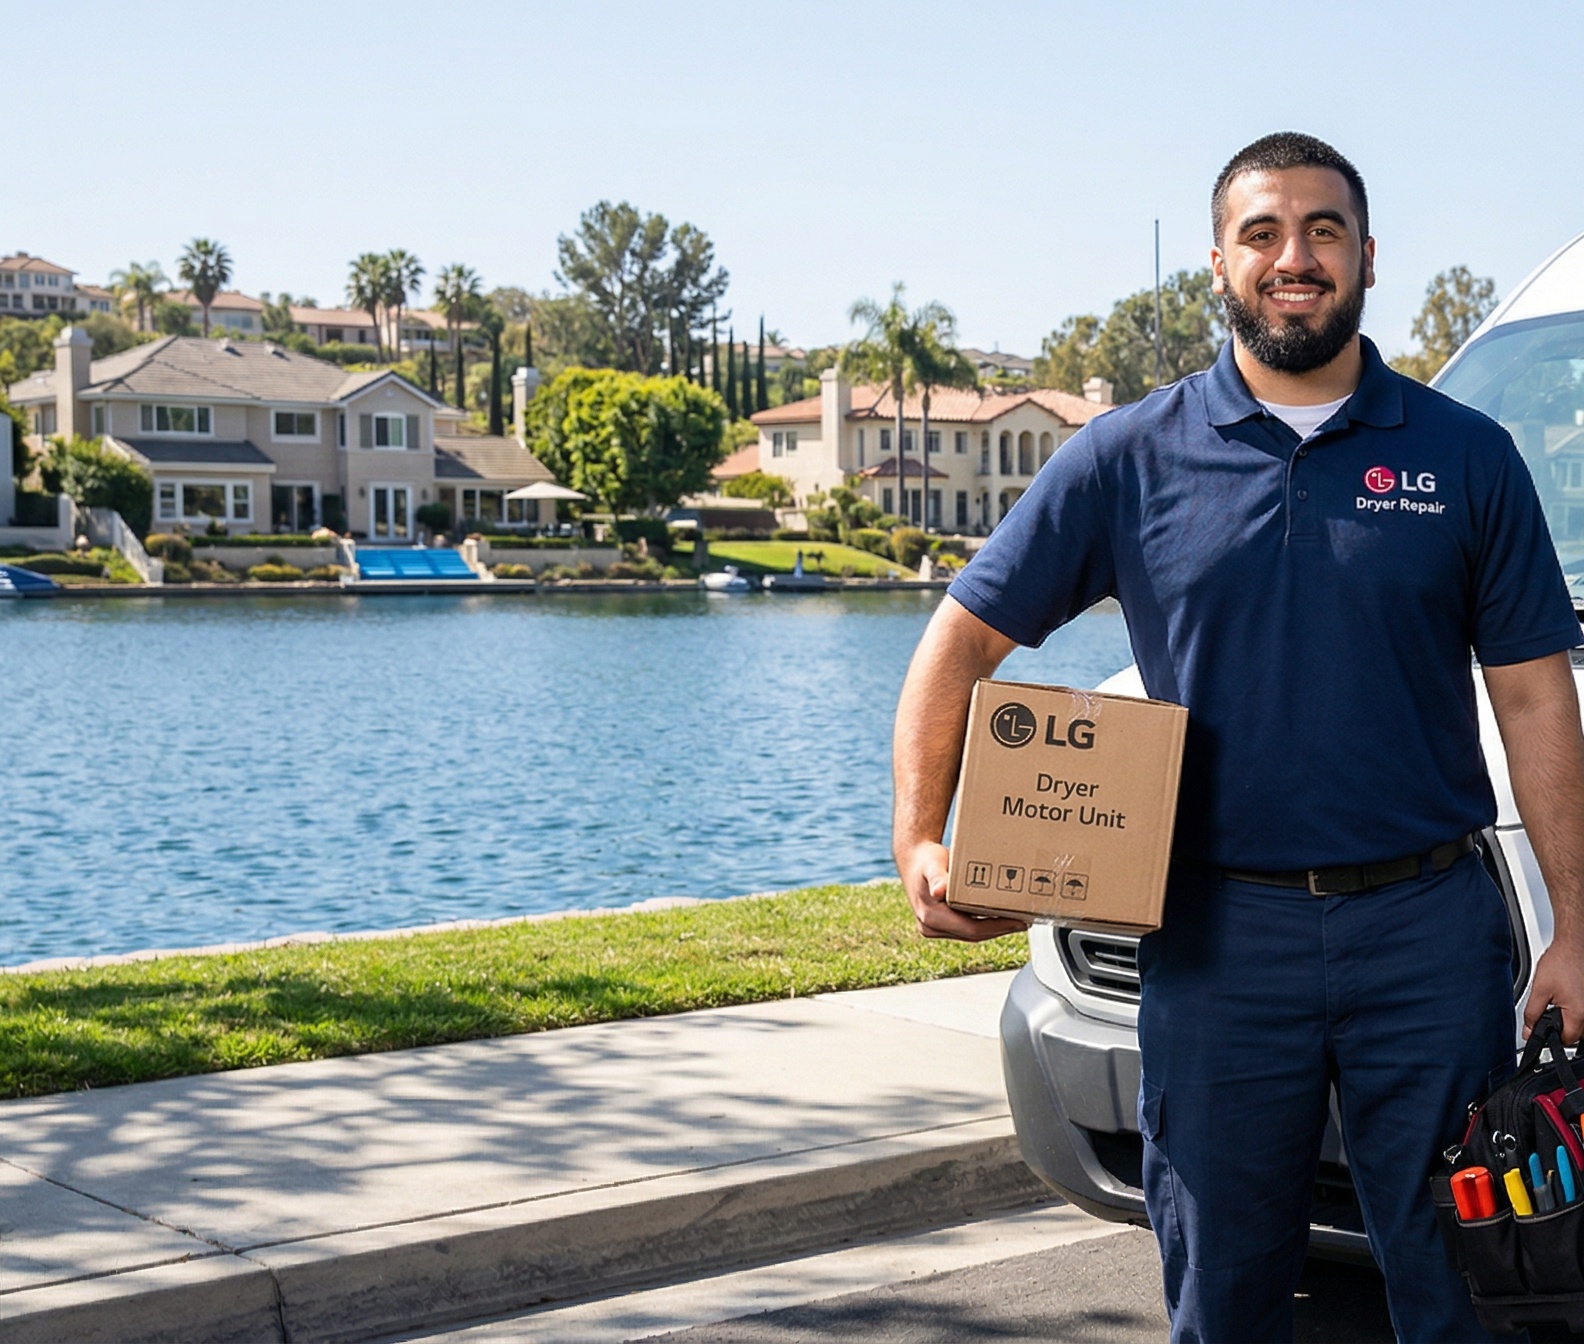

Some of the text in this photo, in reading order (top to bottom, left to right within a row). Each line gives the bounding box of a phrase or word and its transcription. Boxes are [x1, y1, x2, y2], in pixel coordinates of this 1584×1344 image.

[1401, 470, 1436, 493] LG
[1355, 496, 1446, 515] Dryer Repair
[1044, 714, 1096, 750] LG
[1036, 772, 1100, 801] Dryer
[1002, 796, 1126, 830] Motor Unit
